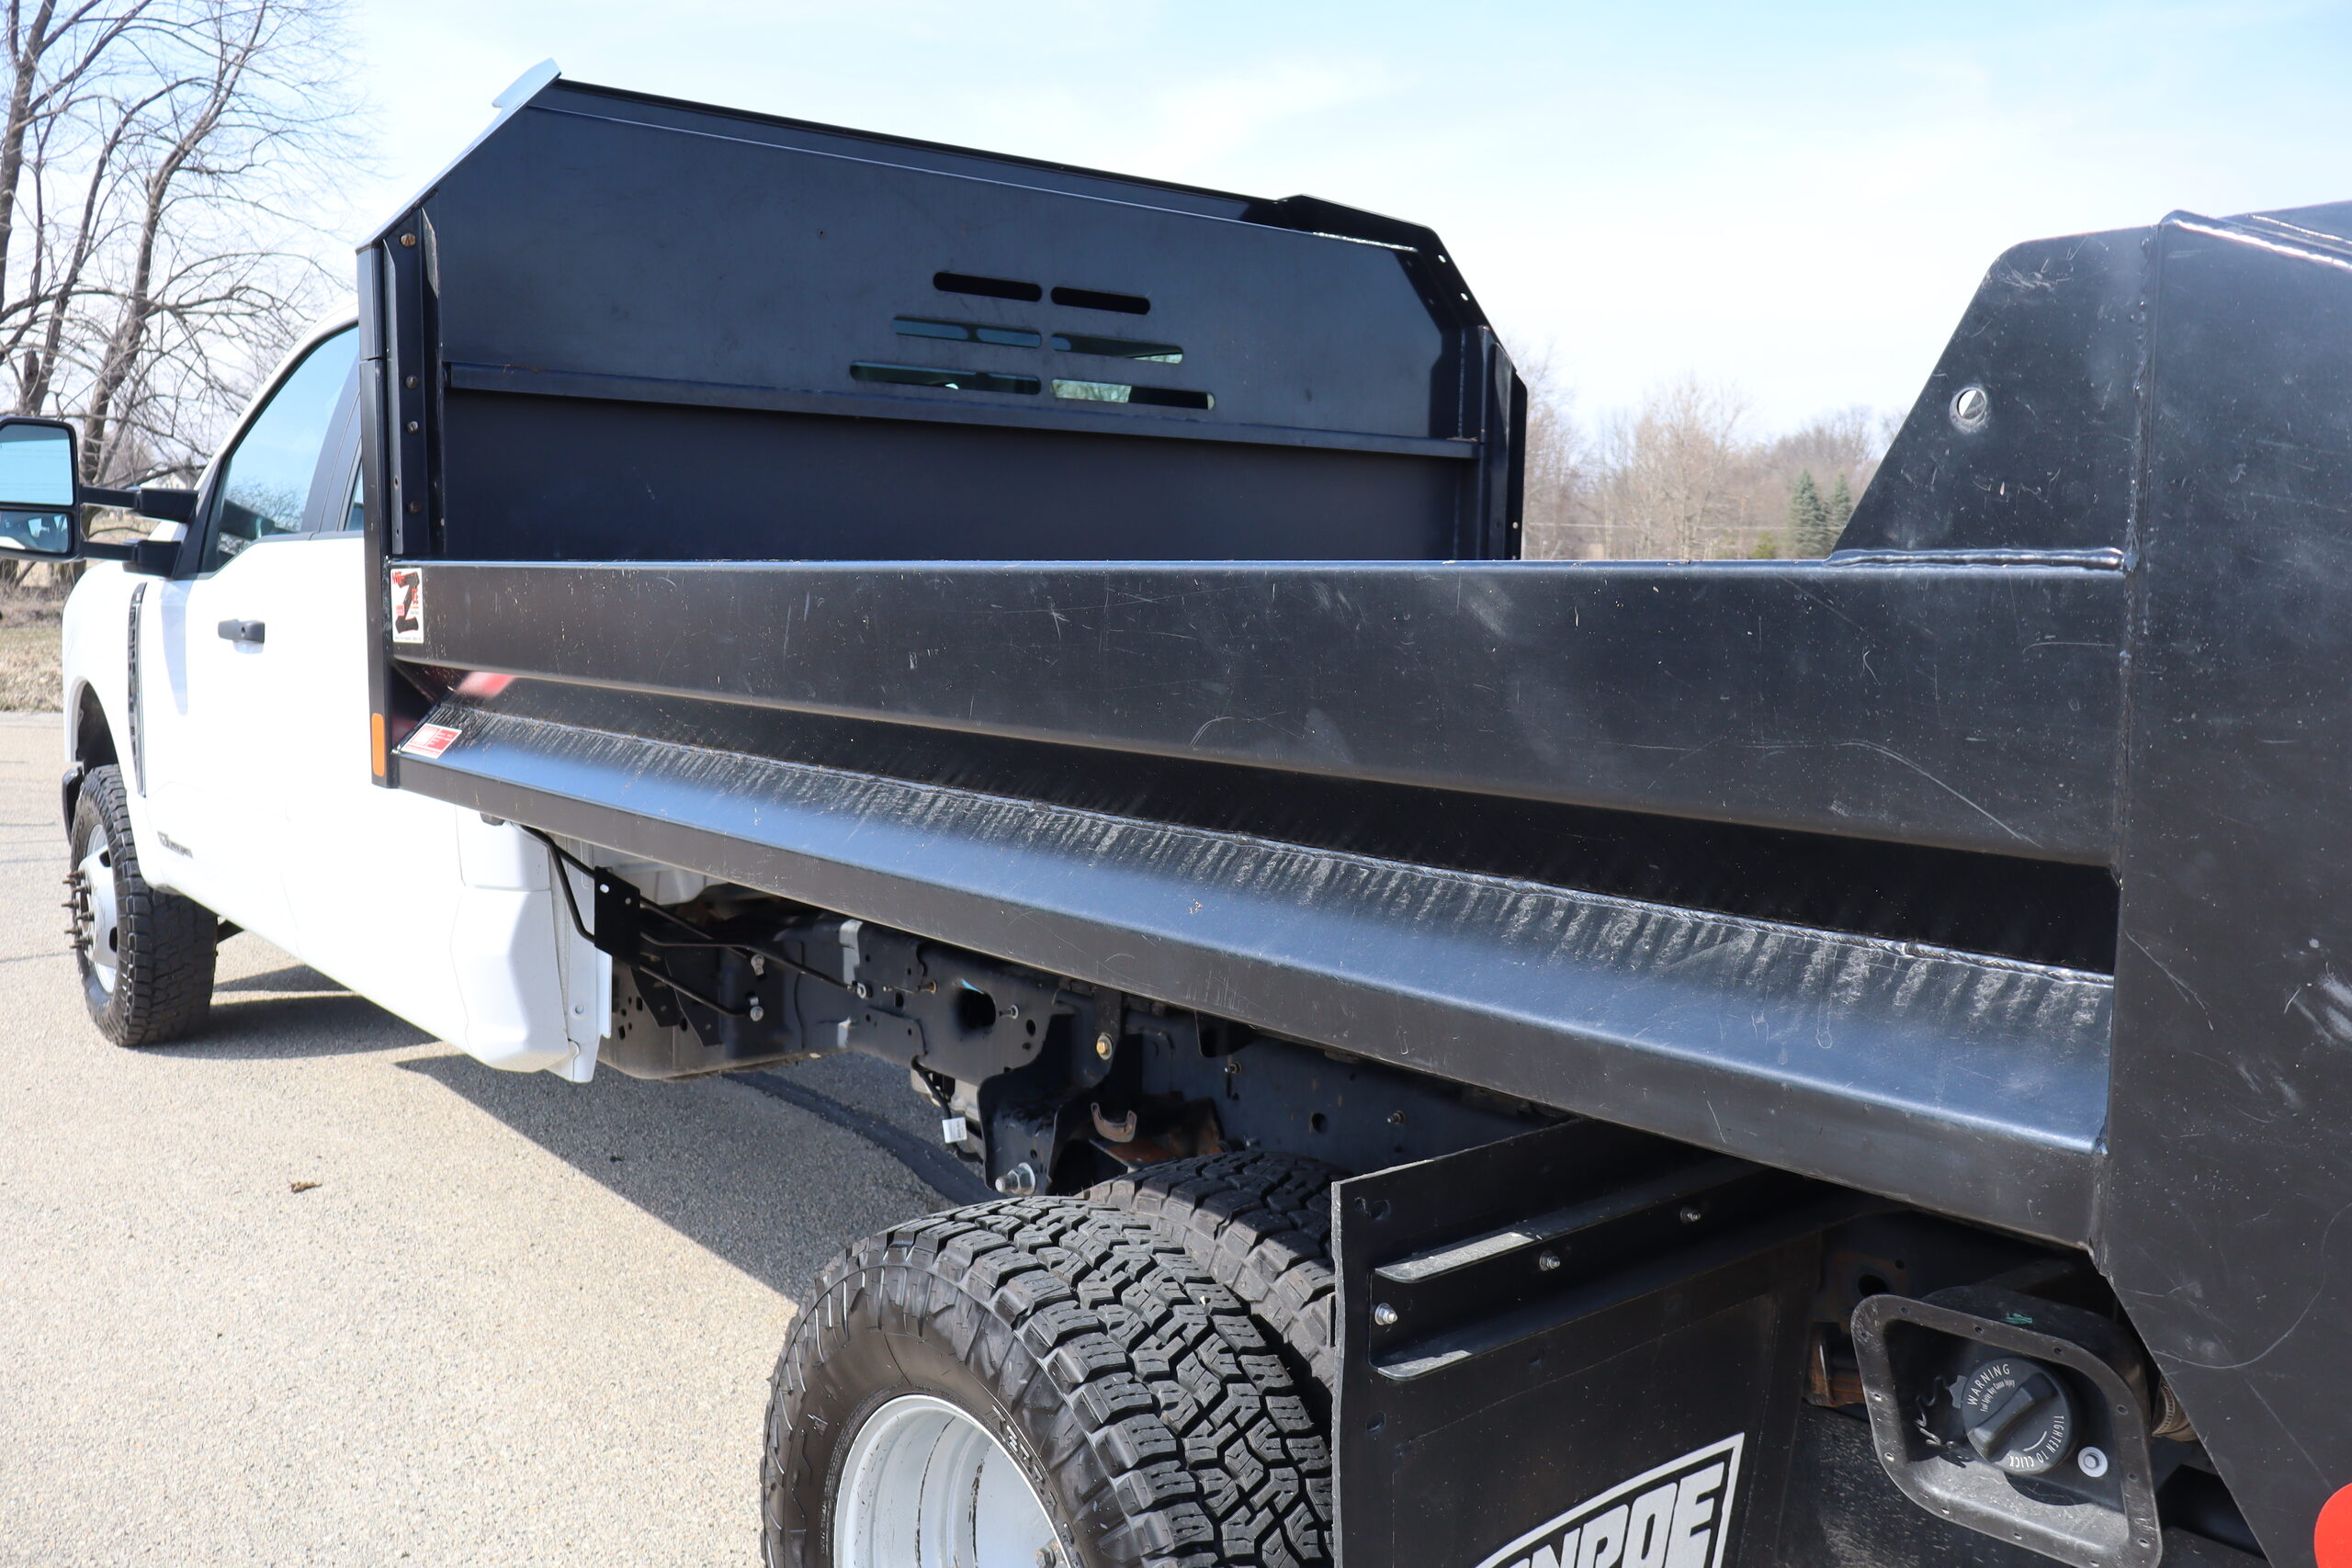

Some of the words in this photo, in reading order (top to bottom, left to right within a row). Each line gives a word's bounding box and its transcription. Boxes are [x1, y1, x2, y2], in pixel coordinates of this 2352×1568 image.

[1967, 1363, 2010, 1405] WARNING
[2045, 1415, 2064, 1454] TIGHTEN
[2009, 1456, 2035, 1468] CLICK
[2035, 1450, 2050, 1463] TO
